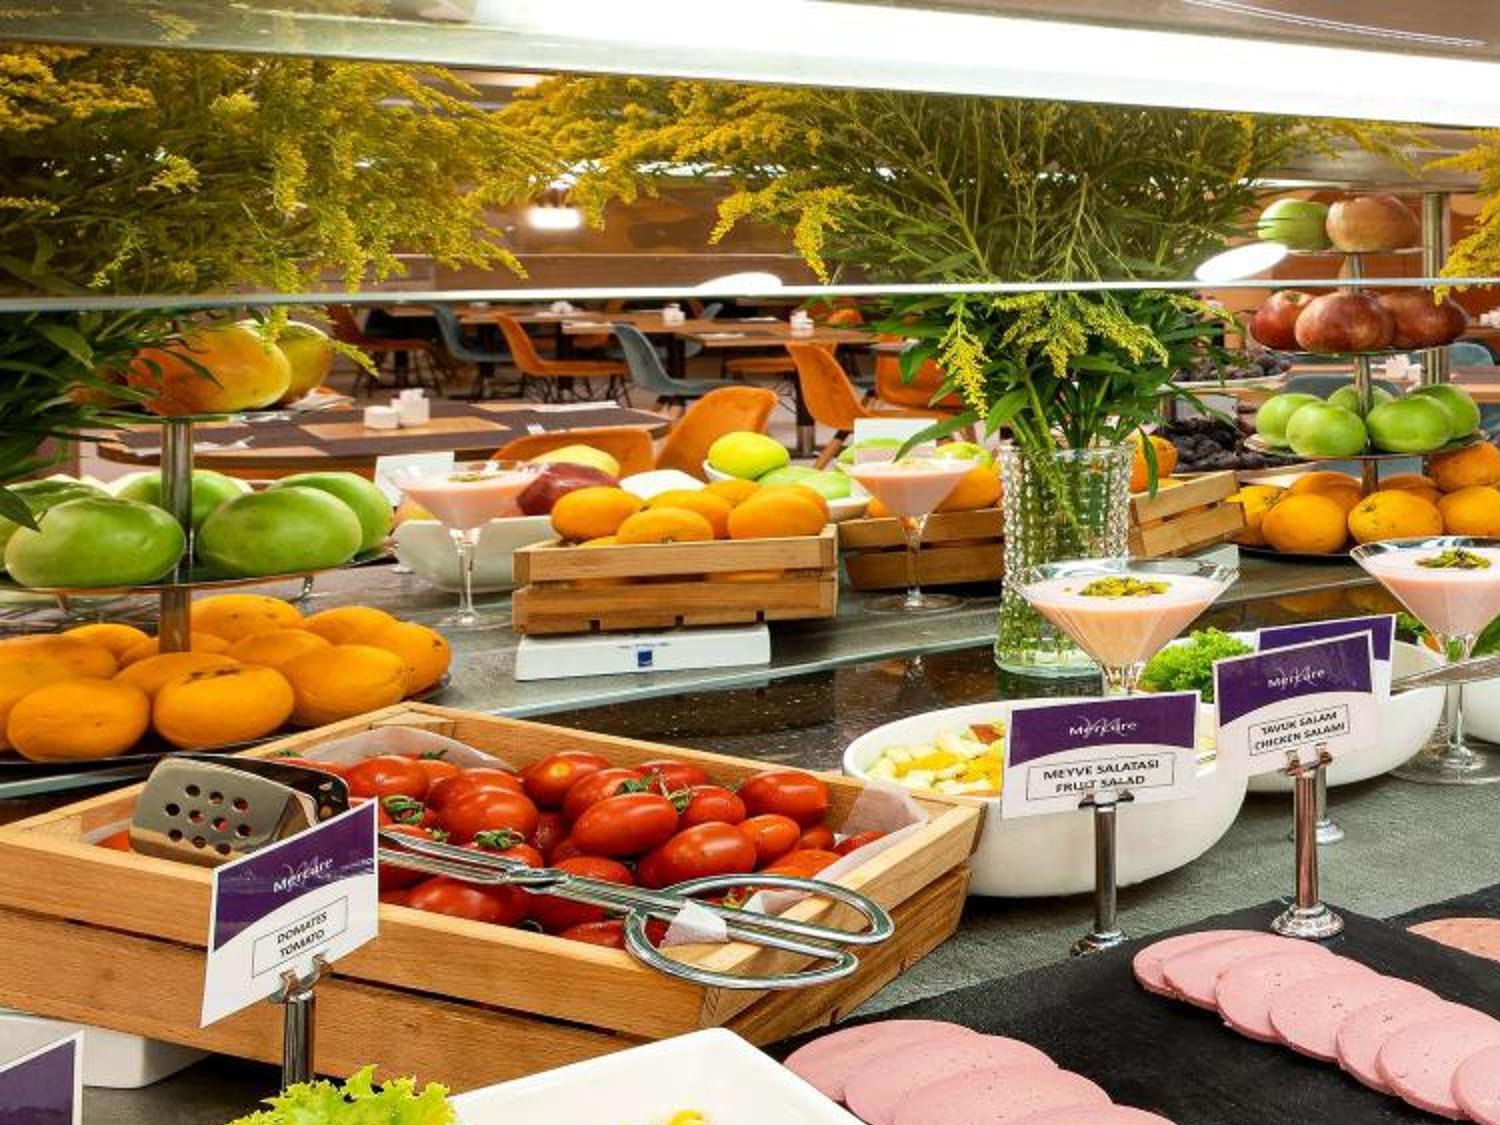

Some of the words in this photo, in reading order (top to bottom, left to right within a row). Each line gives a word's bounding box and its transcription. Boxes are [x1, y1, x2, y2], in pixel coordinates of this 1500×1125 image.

[1255, 731, 1301, 750] CHICKEN
[1043, 766, 1093, 781] MEYVE
[1055, 779, 1098, 794] FRUIT
[1100, 774, 1146, 789] SALAD
[273, 855, 334, 893] Mercure
[276, 911, 328, 945] DOMATES
[278, 929, 325, 957] TOMATO
